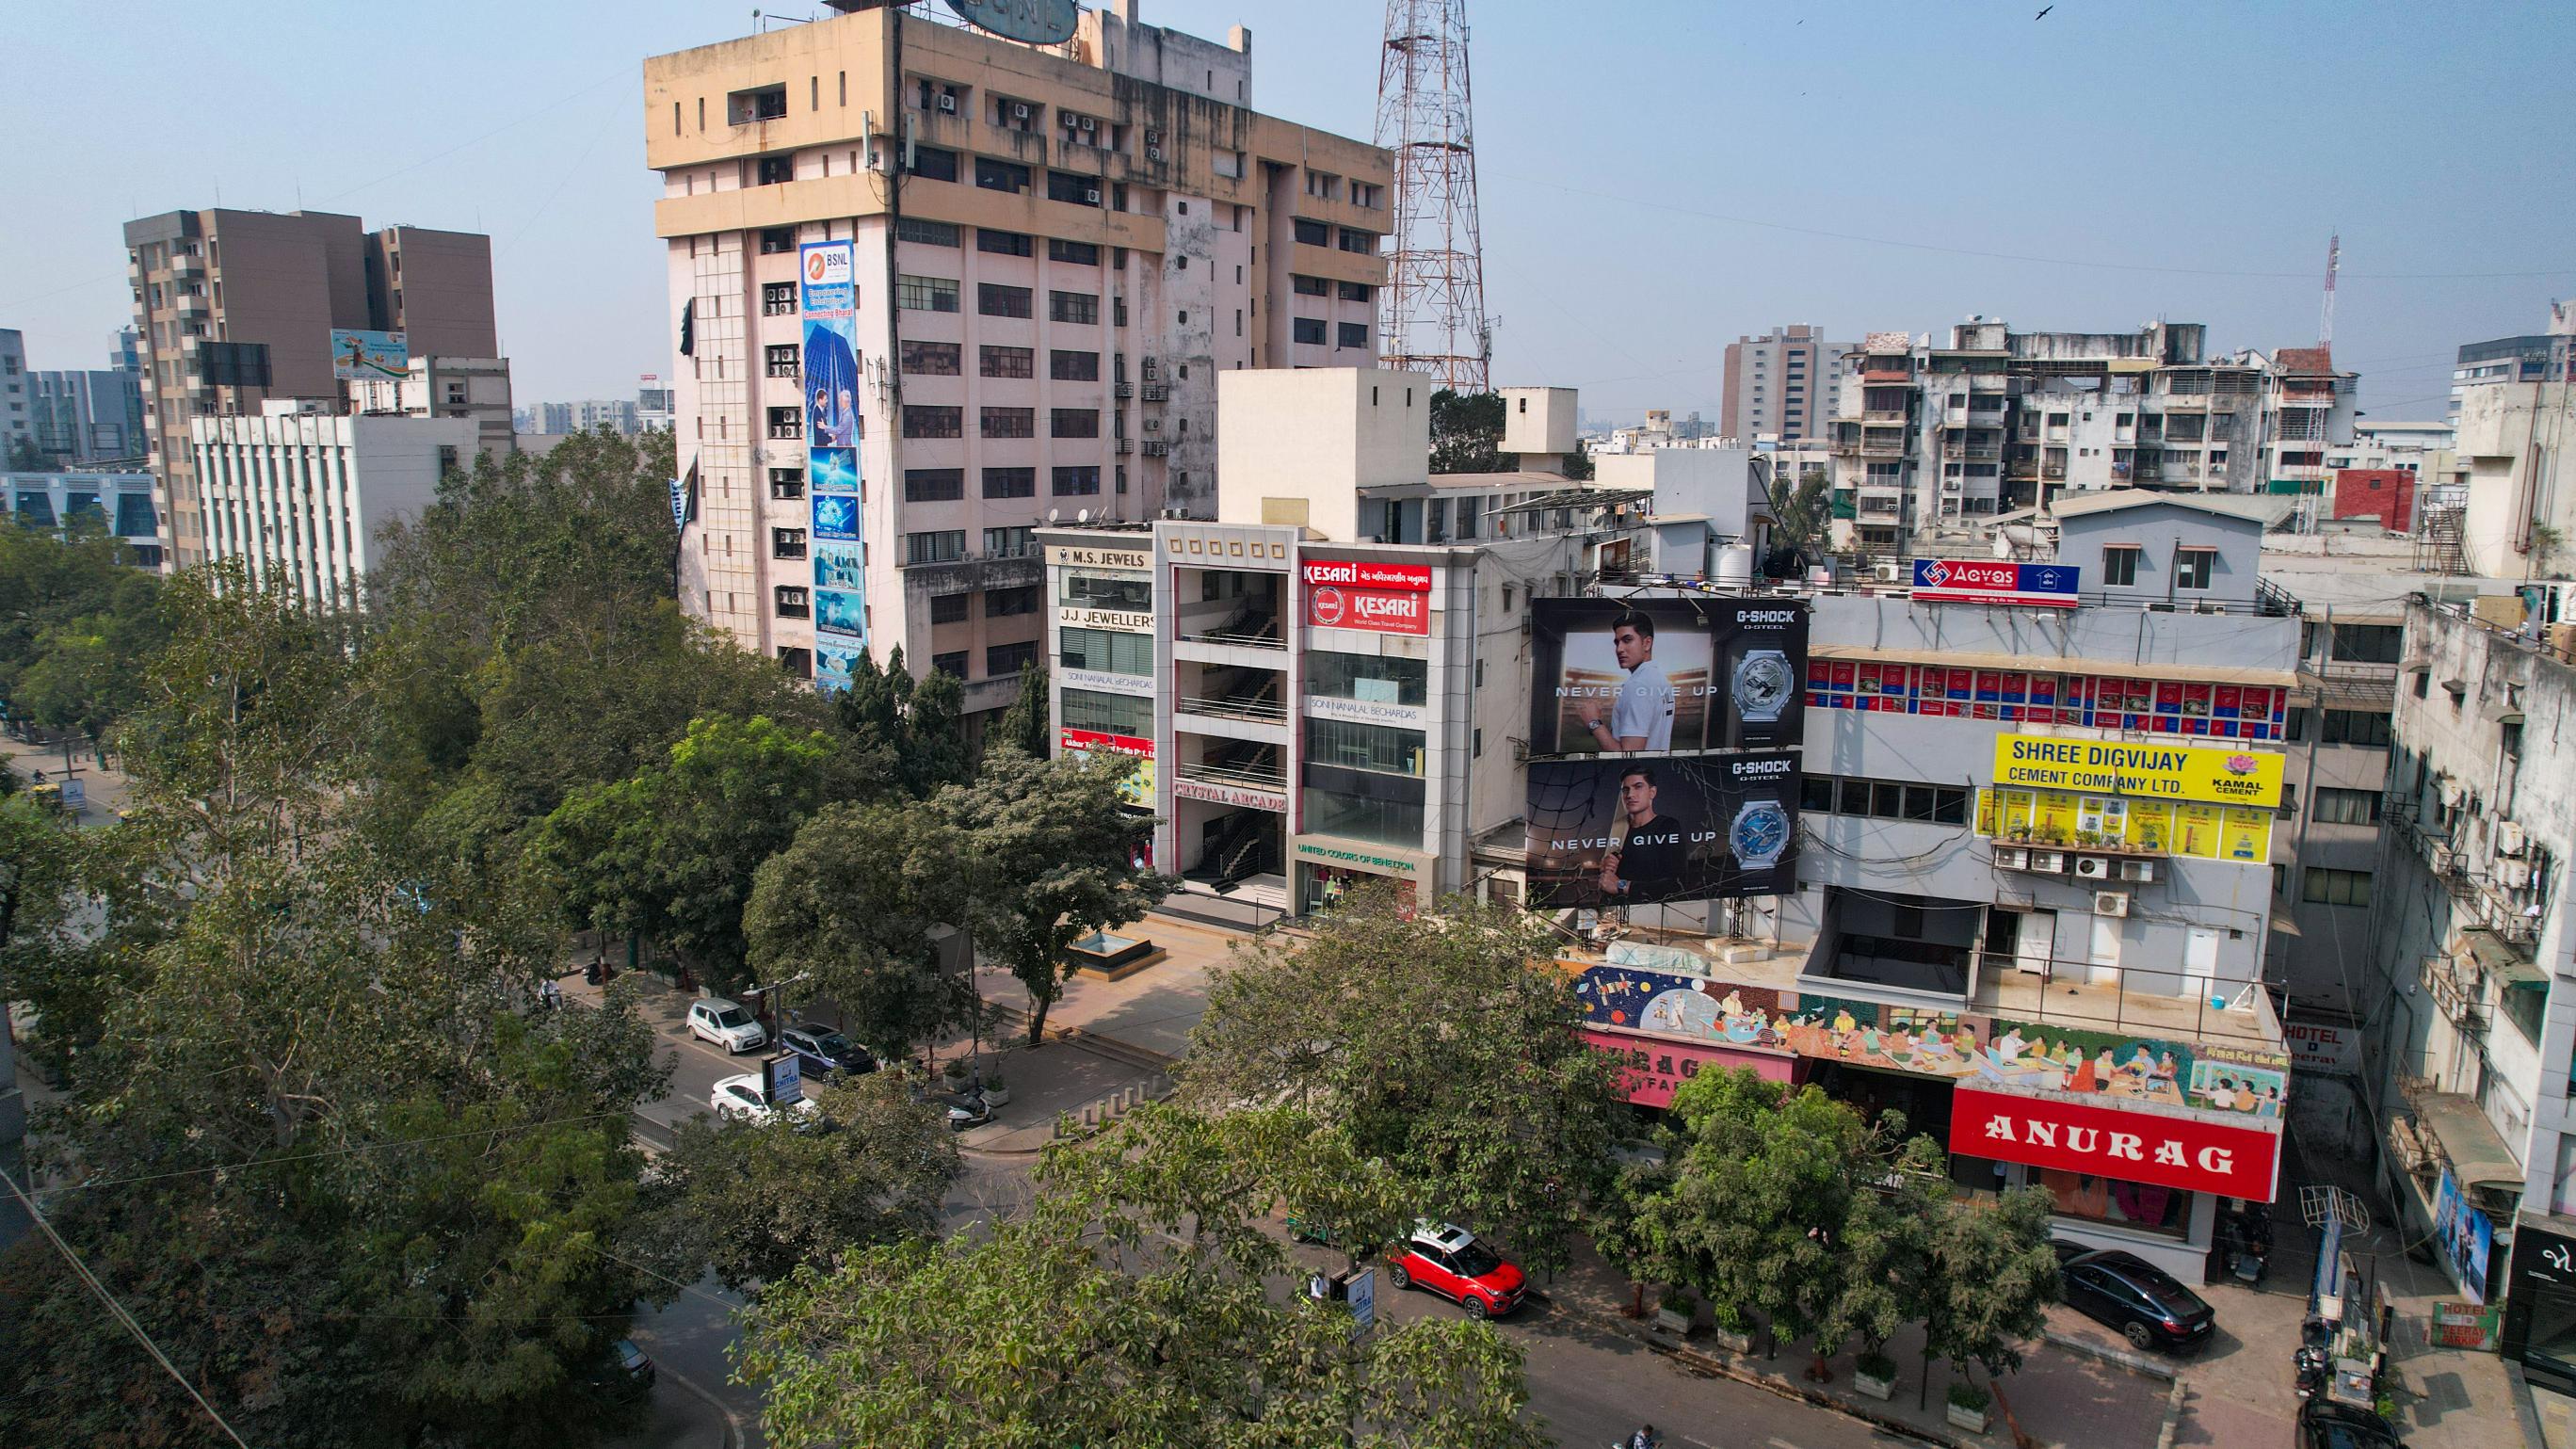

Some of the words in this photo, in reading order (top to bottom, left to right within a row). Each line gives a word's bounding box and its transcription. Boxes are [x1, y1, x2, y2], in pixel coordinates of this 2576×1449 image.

[827, 253, 847, 266] BSNL
[804, 311, 834, 319] Connecting
[1073, 551, 1097, 564] M.S.
[1101, 553, 1145, 567] JEWELS
[1954, 565, 2013, 584] Aavas
[1061, 609, 1080, 621] J.J.
[1737, 610, 1795, 623] G-SHOCK
[1068, 671, 1084, 681] SONI
[1555, 686, 1623, 697] NEVER
[1635, 686, 1681, 697] GIVE
[1693, 686, 1717, 696] UP
[1311, 699, 1329, 708] SONI
[1331, 701, 1368, 715] NANALAL
[1370, 707, 1417, 719] BECHARDAS
[1065, 738, 1084, 748] Akbar
[2012, 740, 2082, 765] SHREE
[2087, 747, 2189, 772] DIGVIJAY
[1732, 760, 1792, 775] G-SHOCK
[2008, 766, 2068, 785] CEMENT
[2151, 779, 2186, 795] LTD.
[2213, 779, 2264, 791] KAMAL
[1175, 782, 1229, 801] CRYSTAL
[1231, 791, 1285, 812] ARCADE
[2215, 787, 2260, 797] CEMENT
[1552, 837, 1620, 851] NEVER
[1633, 833, 1679, 845] GIVE
[1691, 831, 1716, 843] UP
[1298, 844, 1327, 856] UNITED
[1328, 849, 1359, 861] COLORS
[1360, 855, 1371, 863] OF
[2285, 1024, 2343, 1044] HOTEL
[775, 1074, 798, 1088] CHITRA
[1985, 1115, 2234, 1175] ANURAG
[2443, 1304, 2487, 1315] HOTEL
